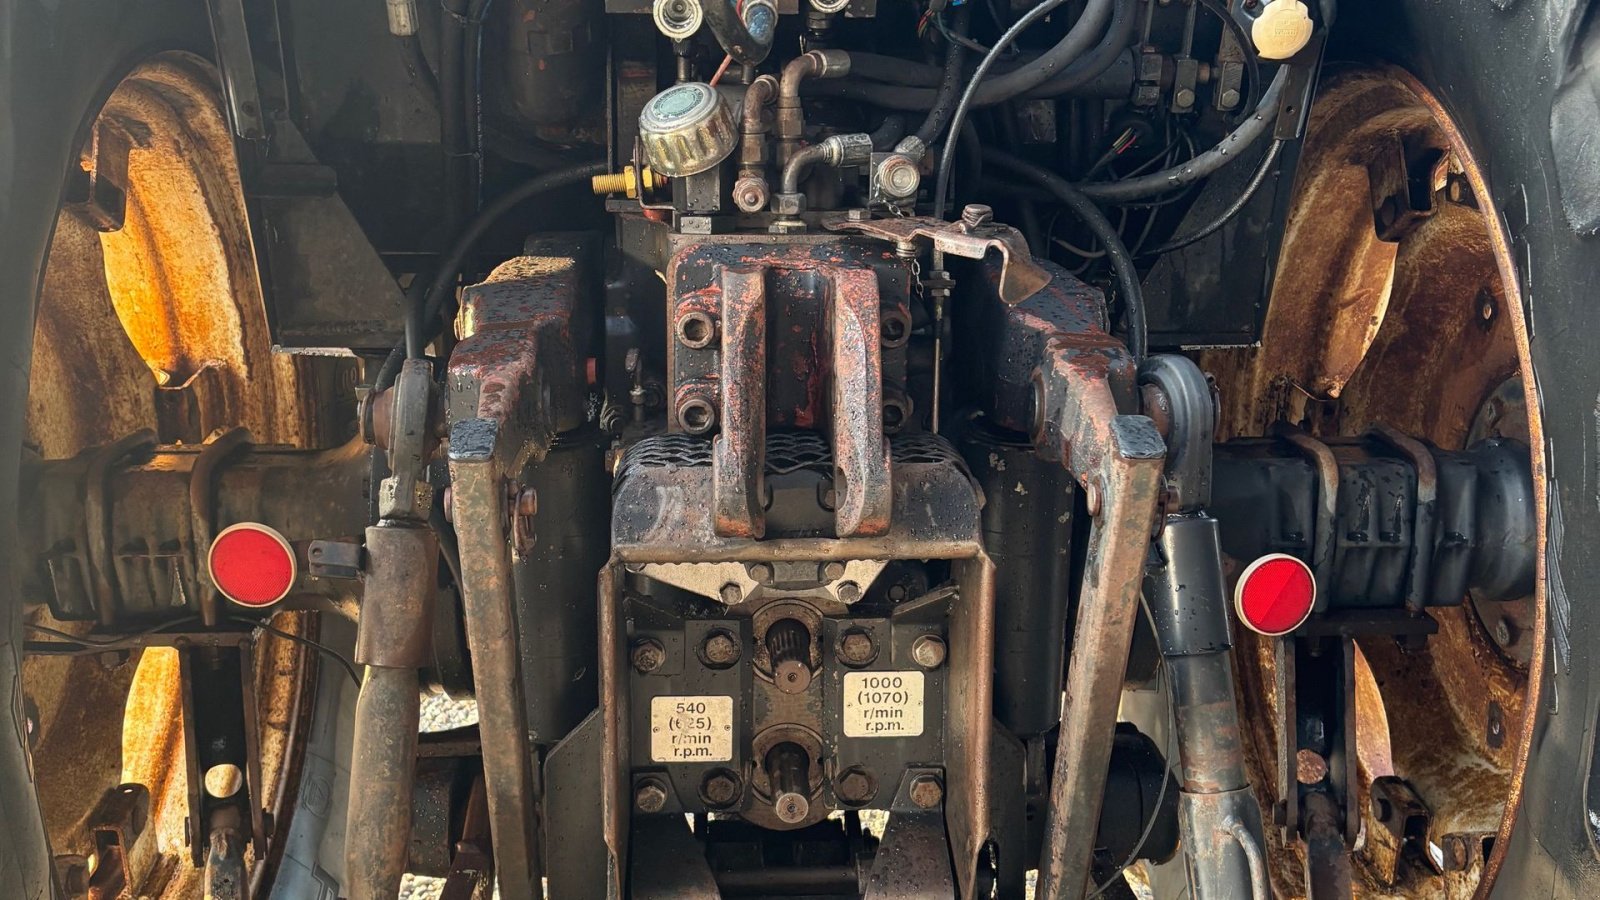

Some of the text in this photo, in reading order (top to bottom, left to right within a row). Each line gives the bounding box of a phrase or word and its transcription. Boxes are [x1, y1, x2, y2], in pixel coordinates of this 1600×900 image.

[862, 677, 902, 688] 1000
[858, 691, 908, 705] (1070)
[676, 702, 706, 714] 540
[864, 706, 903, 720] r/min
[866, 722, 904, 733] r.p.m.
[672, 732, 711, 745] r/min
[674, 747, 713, 759] r.p.m.
